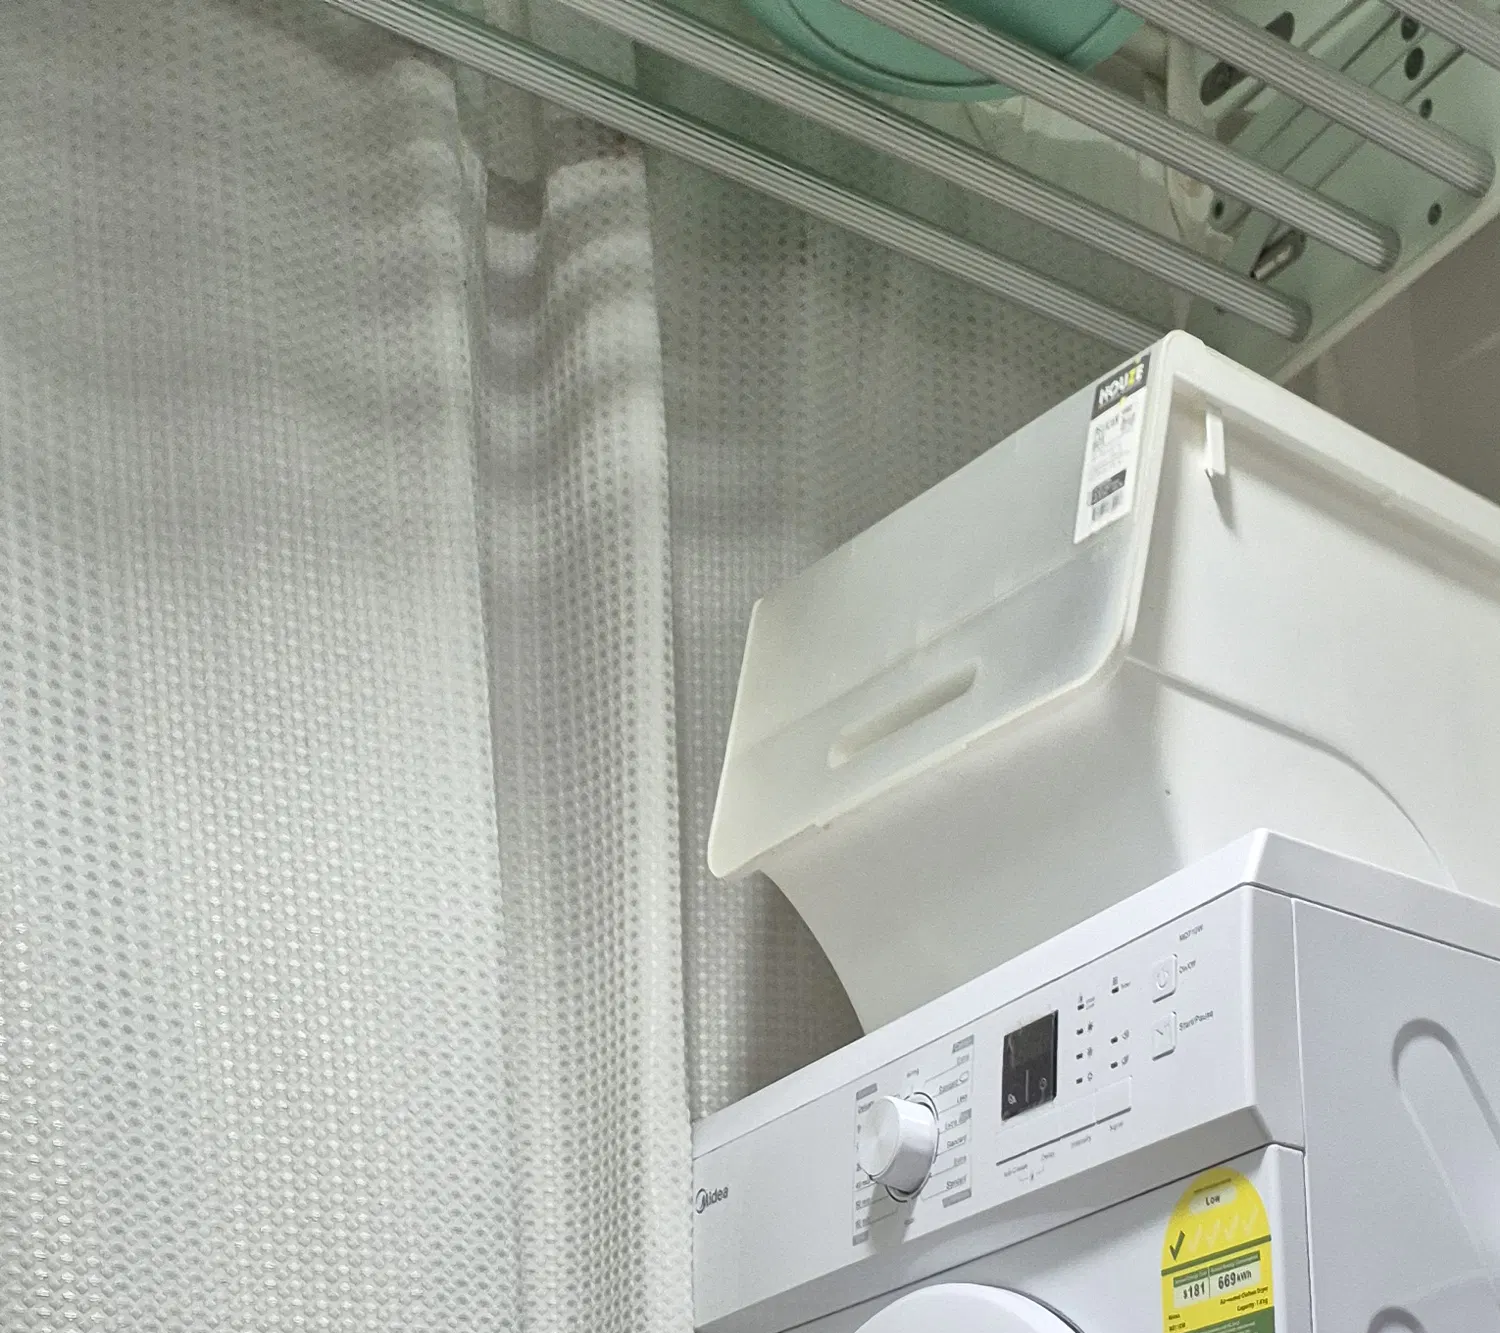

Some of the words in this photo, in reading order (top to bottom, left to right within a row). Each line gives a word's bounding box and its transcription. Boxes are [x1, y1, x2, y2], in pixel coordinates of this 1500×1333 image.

[1179, 1010, 1214, 1032] Start/Pause
[696, 1187, 728, 1214] Midea
[1205, 1196, 1220, 1206] Low
[1183, 1281, 1205, 1299] $181
